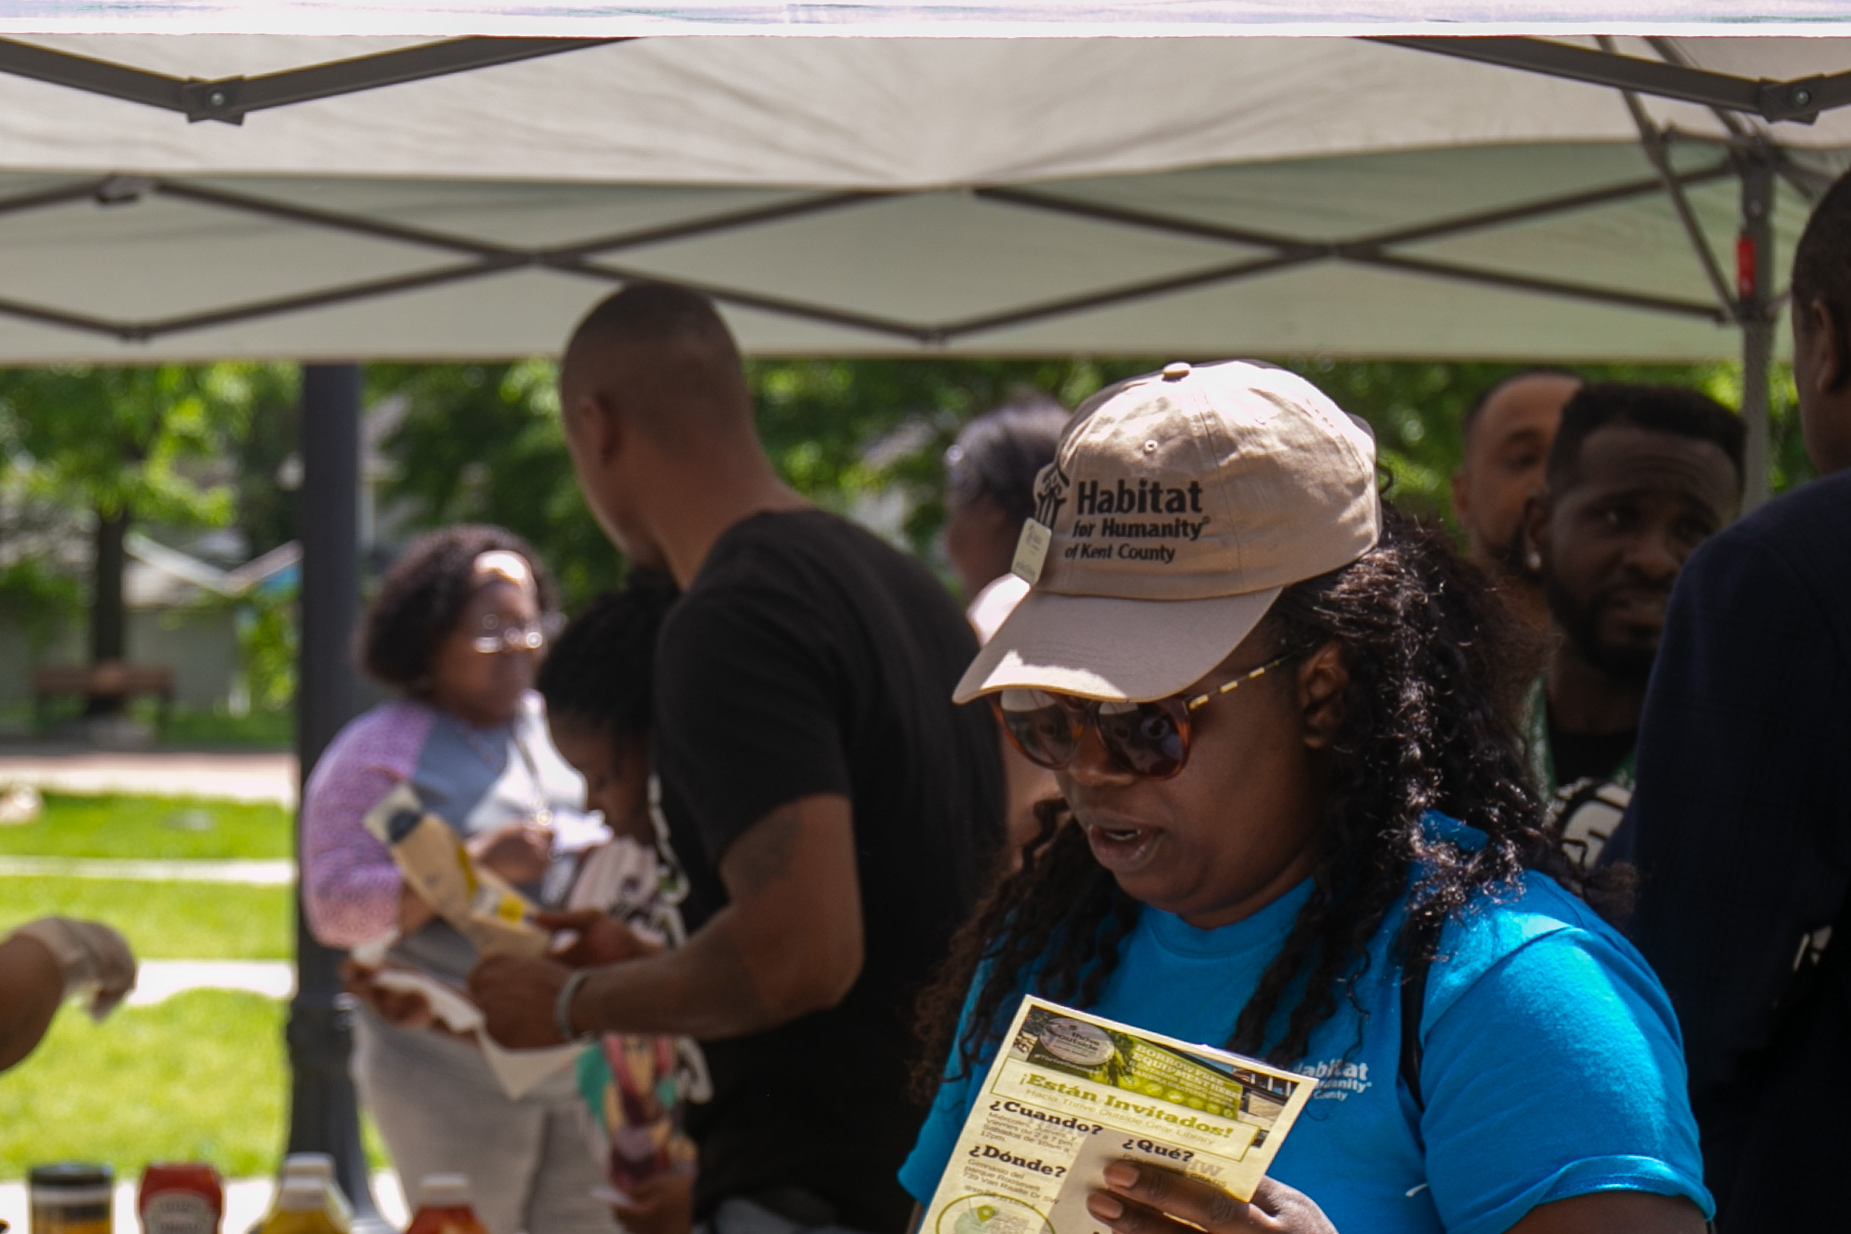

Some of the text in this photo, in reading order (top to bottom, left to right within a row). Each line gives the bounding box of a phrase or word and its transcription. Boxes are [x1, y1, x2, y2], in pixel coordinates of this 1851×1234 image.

[1076, 478, 1204, 516] Habitat
[1072, 519, 1096, 539] for
[1065, 543, 1176, 564] of Kent County
[1019, 1073, 1098, 1102] ¡Están
[1104, 1094, 1235, 1139] Invitados!
[968, 1144, 1067, 1178] ¿Dónde?
[1122, 1138, 1195, 1163] ¿Qué?
